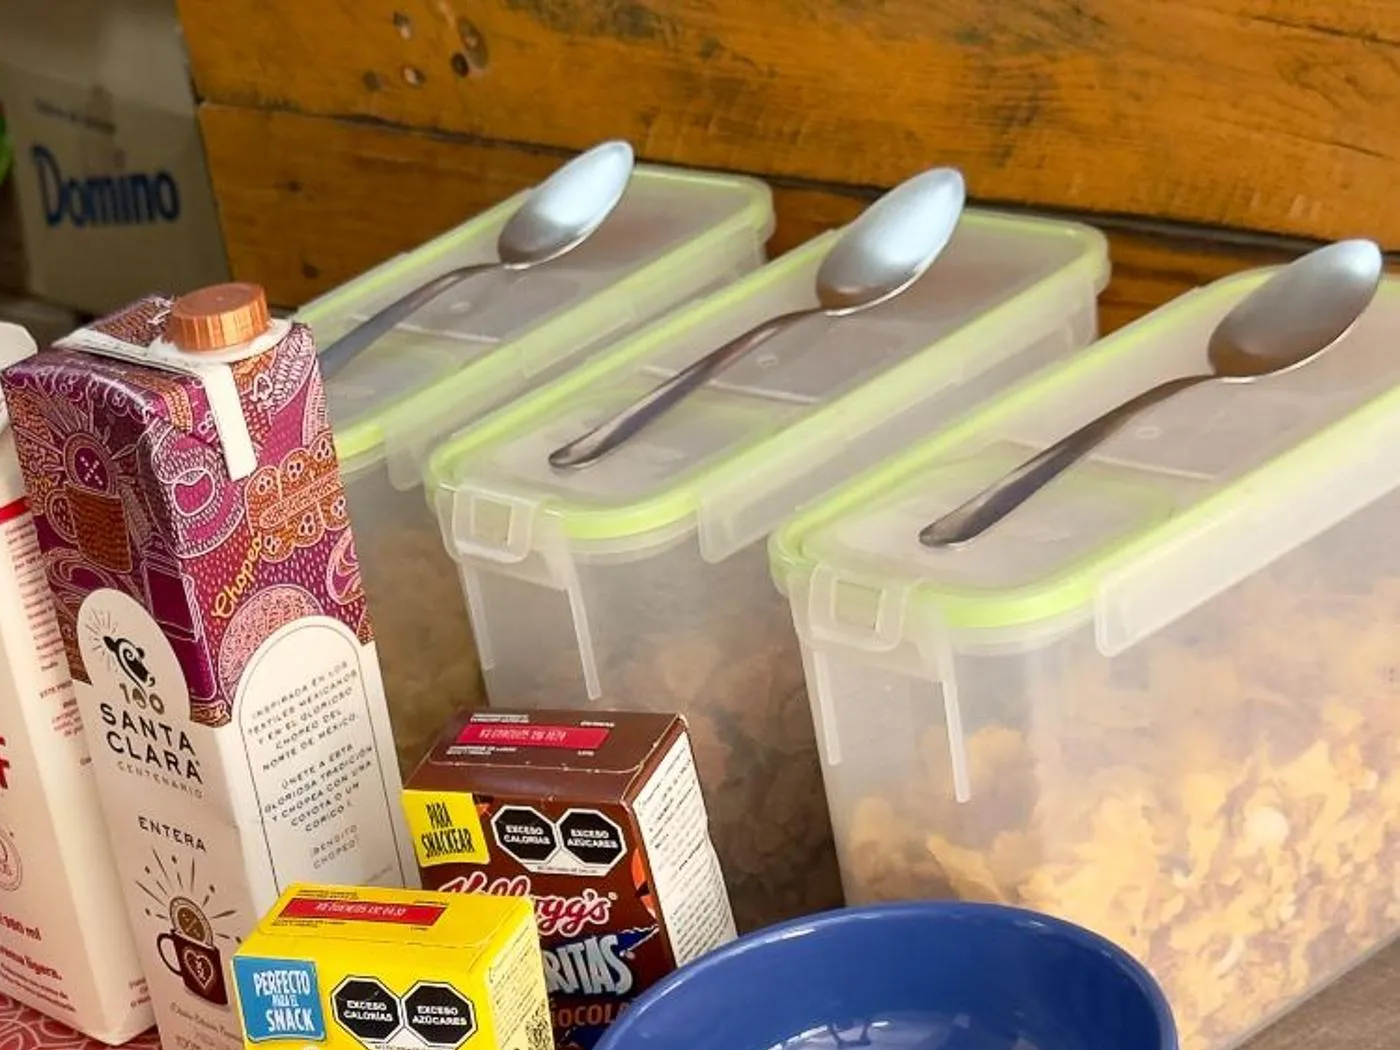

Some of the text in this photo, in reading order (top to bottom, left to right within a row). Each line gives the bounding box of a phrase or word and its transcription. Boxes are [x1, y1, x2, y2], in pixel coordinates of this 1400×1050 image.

[32, 144, 180, 229] Domino
[100, 703, 197, 756] SANTA
[106, 731, 203, 785] CLARA
[426, 802, 453, 829] PARA
[138, 815, 206, 852] ENTERA
[421, 828, 475, 853] SNACKEAR
[505, 824, 544, 835] EXCESO
[570, 828, 609, 839] EXCESO
[253, 970, 312, 996] PERFECTO
[343, 1009, 394, 1023] CALORÍAS
[346, 1000, 387, 1011] EXCESO
[416, 1005, 458, 1016] EXCESO
[265, 1008, 316, 1032] SNACK
[412, 1013, 468, 1026] AZÚCARES
